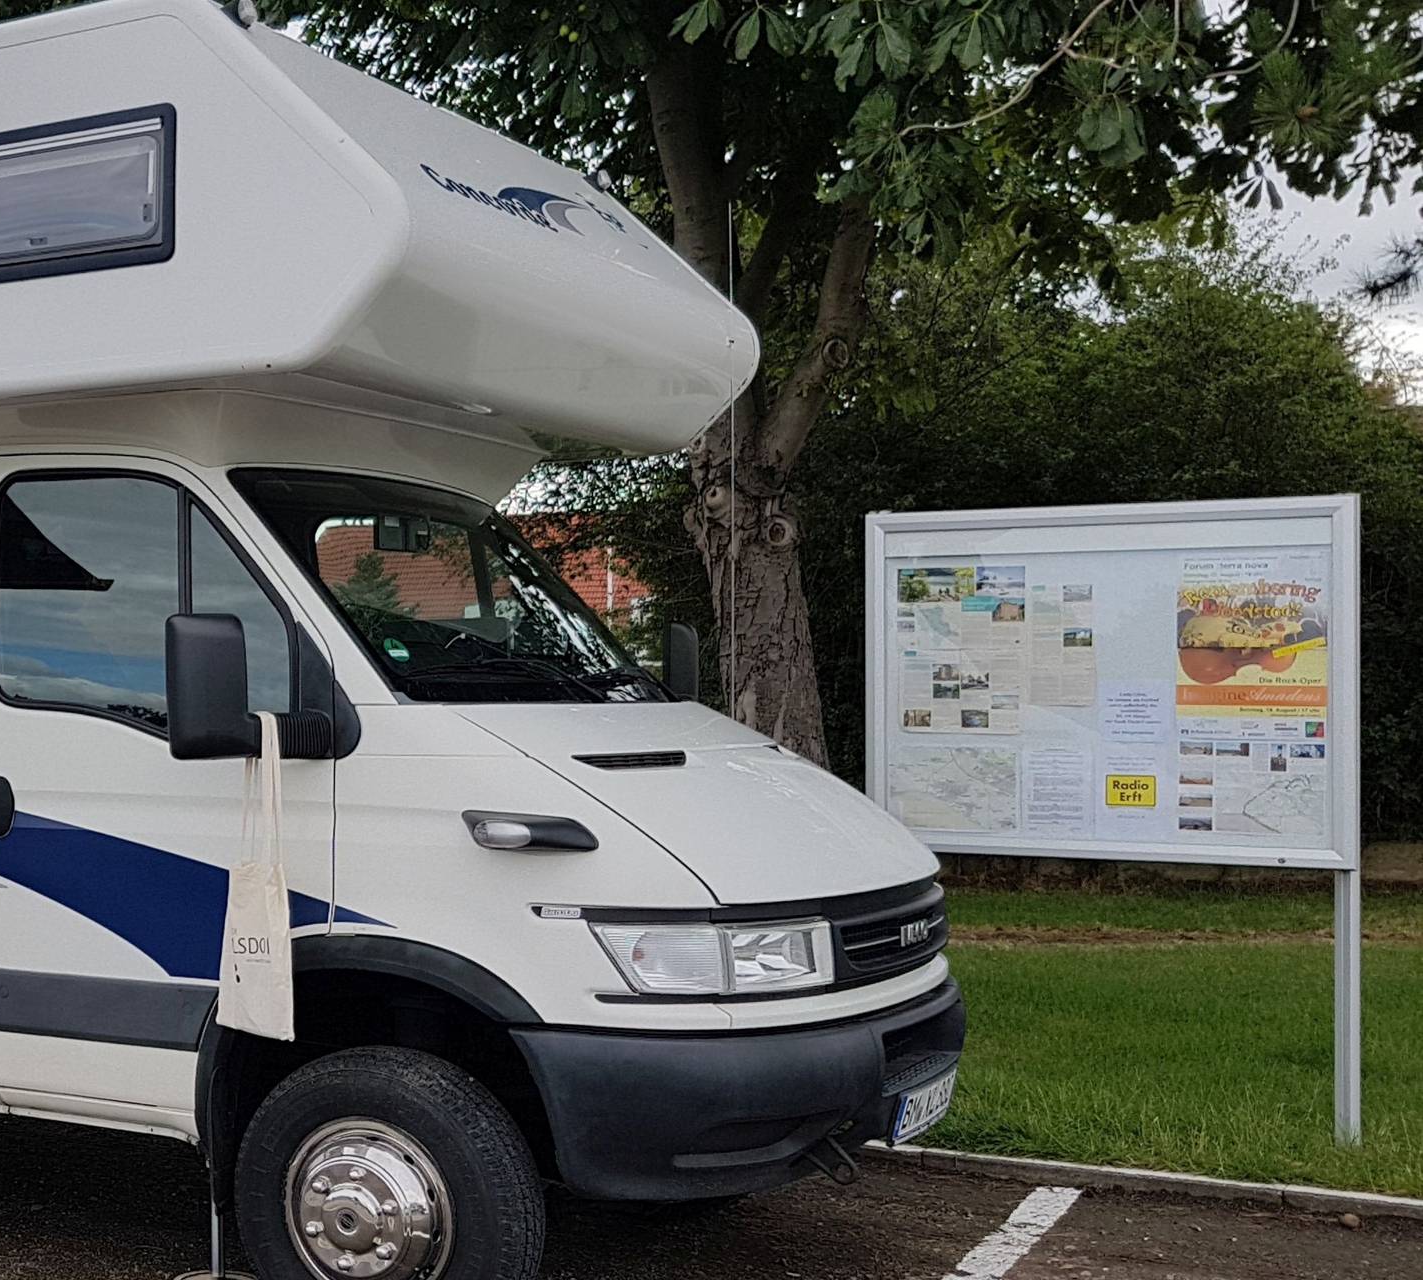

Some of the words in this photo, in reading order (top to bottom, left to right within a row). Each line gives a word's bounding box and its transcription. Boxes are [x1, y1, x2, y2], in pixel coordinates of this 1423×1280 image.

[420, 163, 559, 233] Concorde
[1112, 780, 1149, 791] Radio
[1119, 791, 1143, 802] Erft
